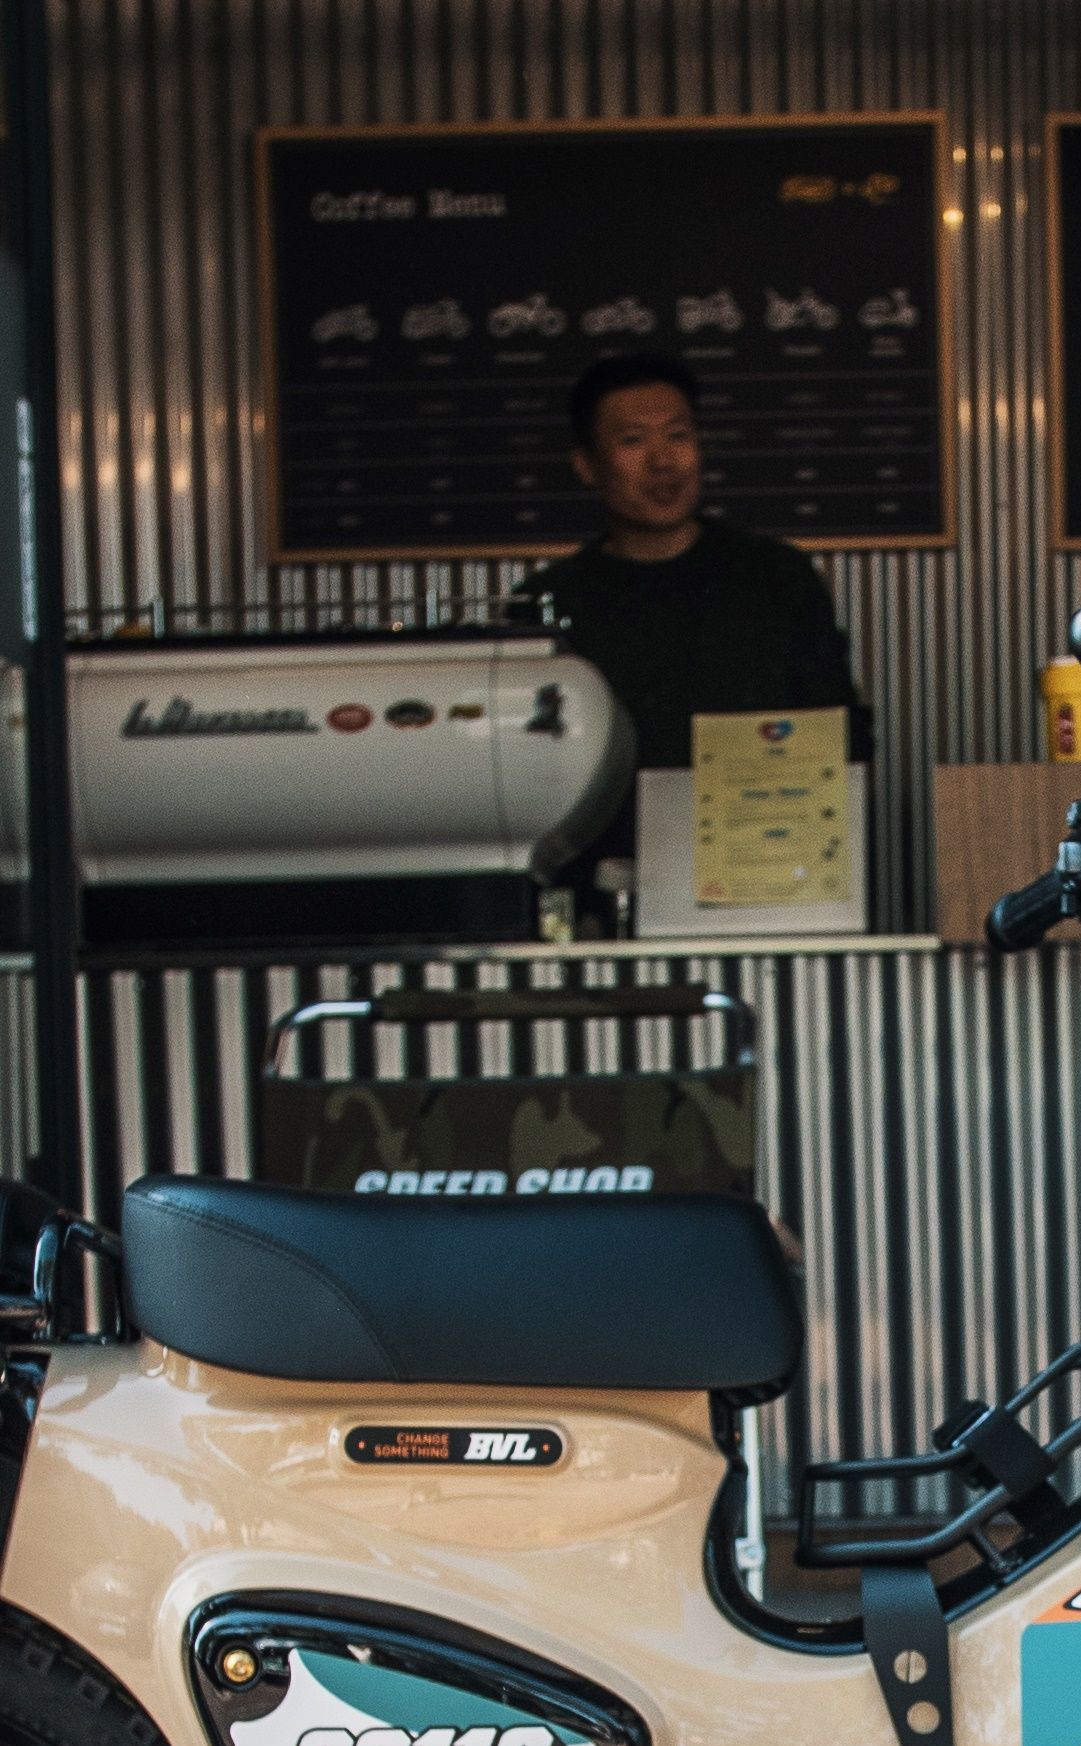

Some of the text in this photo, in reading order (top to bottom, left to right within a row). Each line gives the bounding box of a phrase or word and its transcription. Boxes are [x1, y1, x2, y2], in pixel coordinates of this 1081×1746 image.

[396, 1431, 449, 1444] CHANGE
[374, 1444, 449, 1458] SOMETHING
[464, 1432, 537, 1461] BVL
